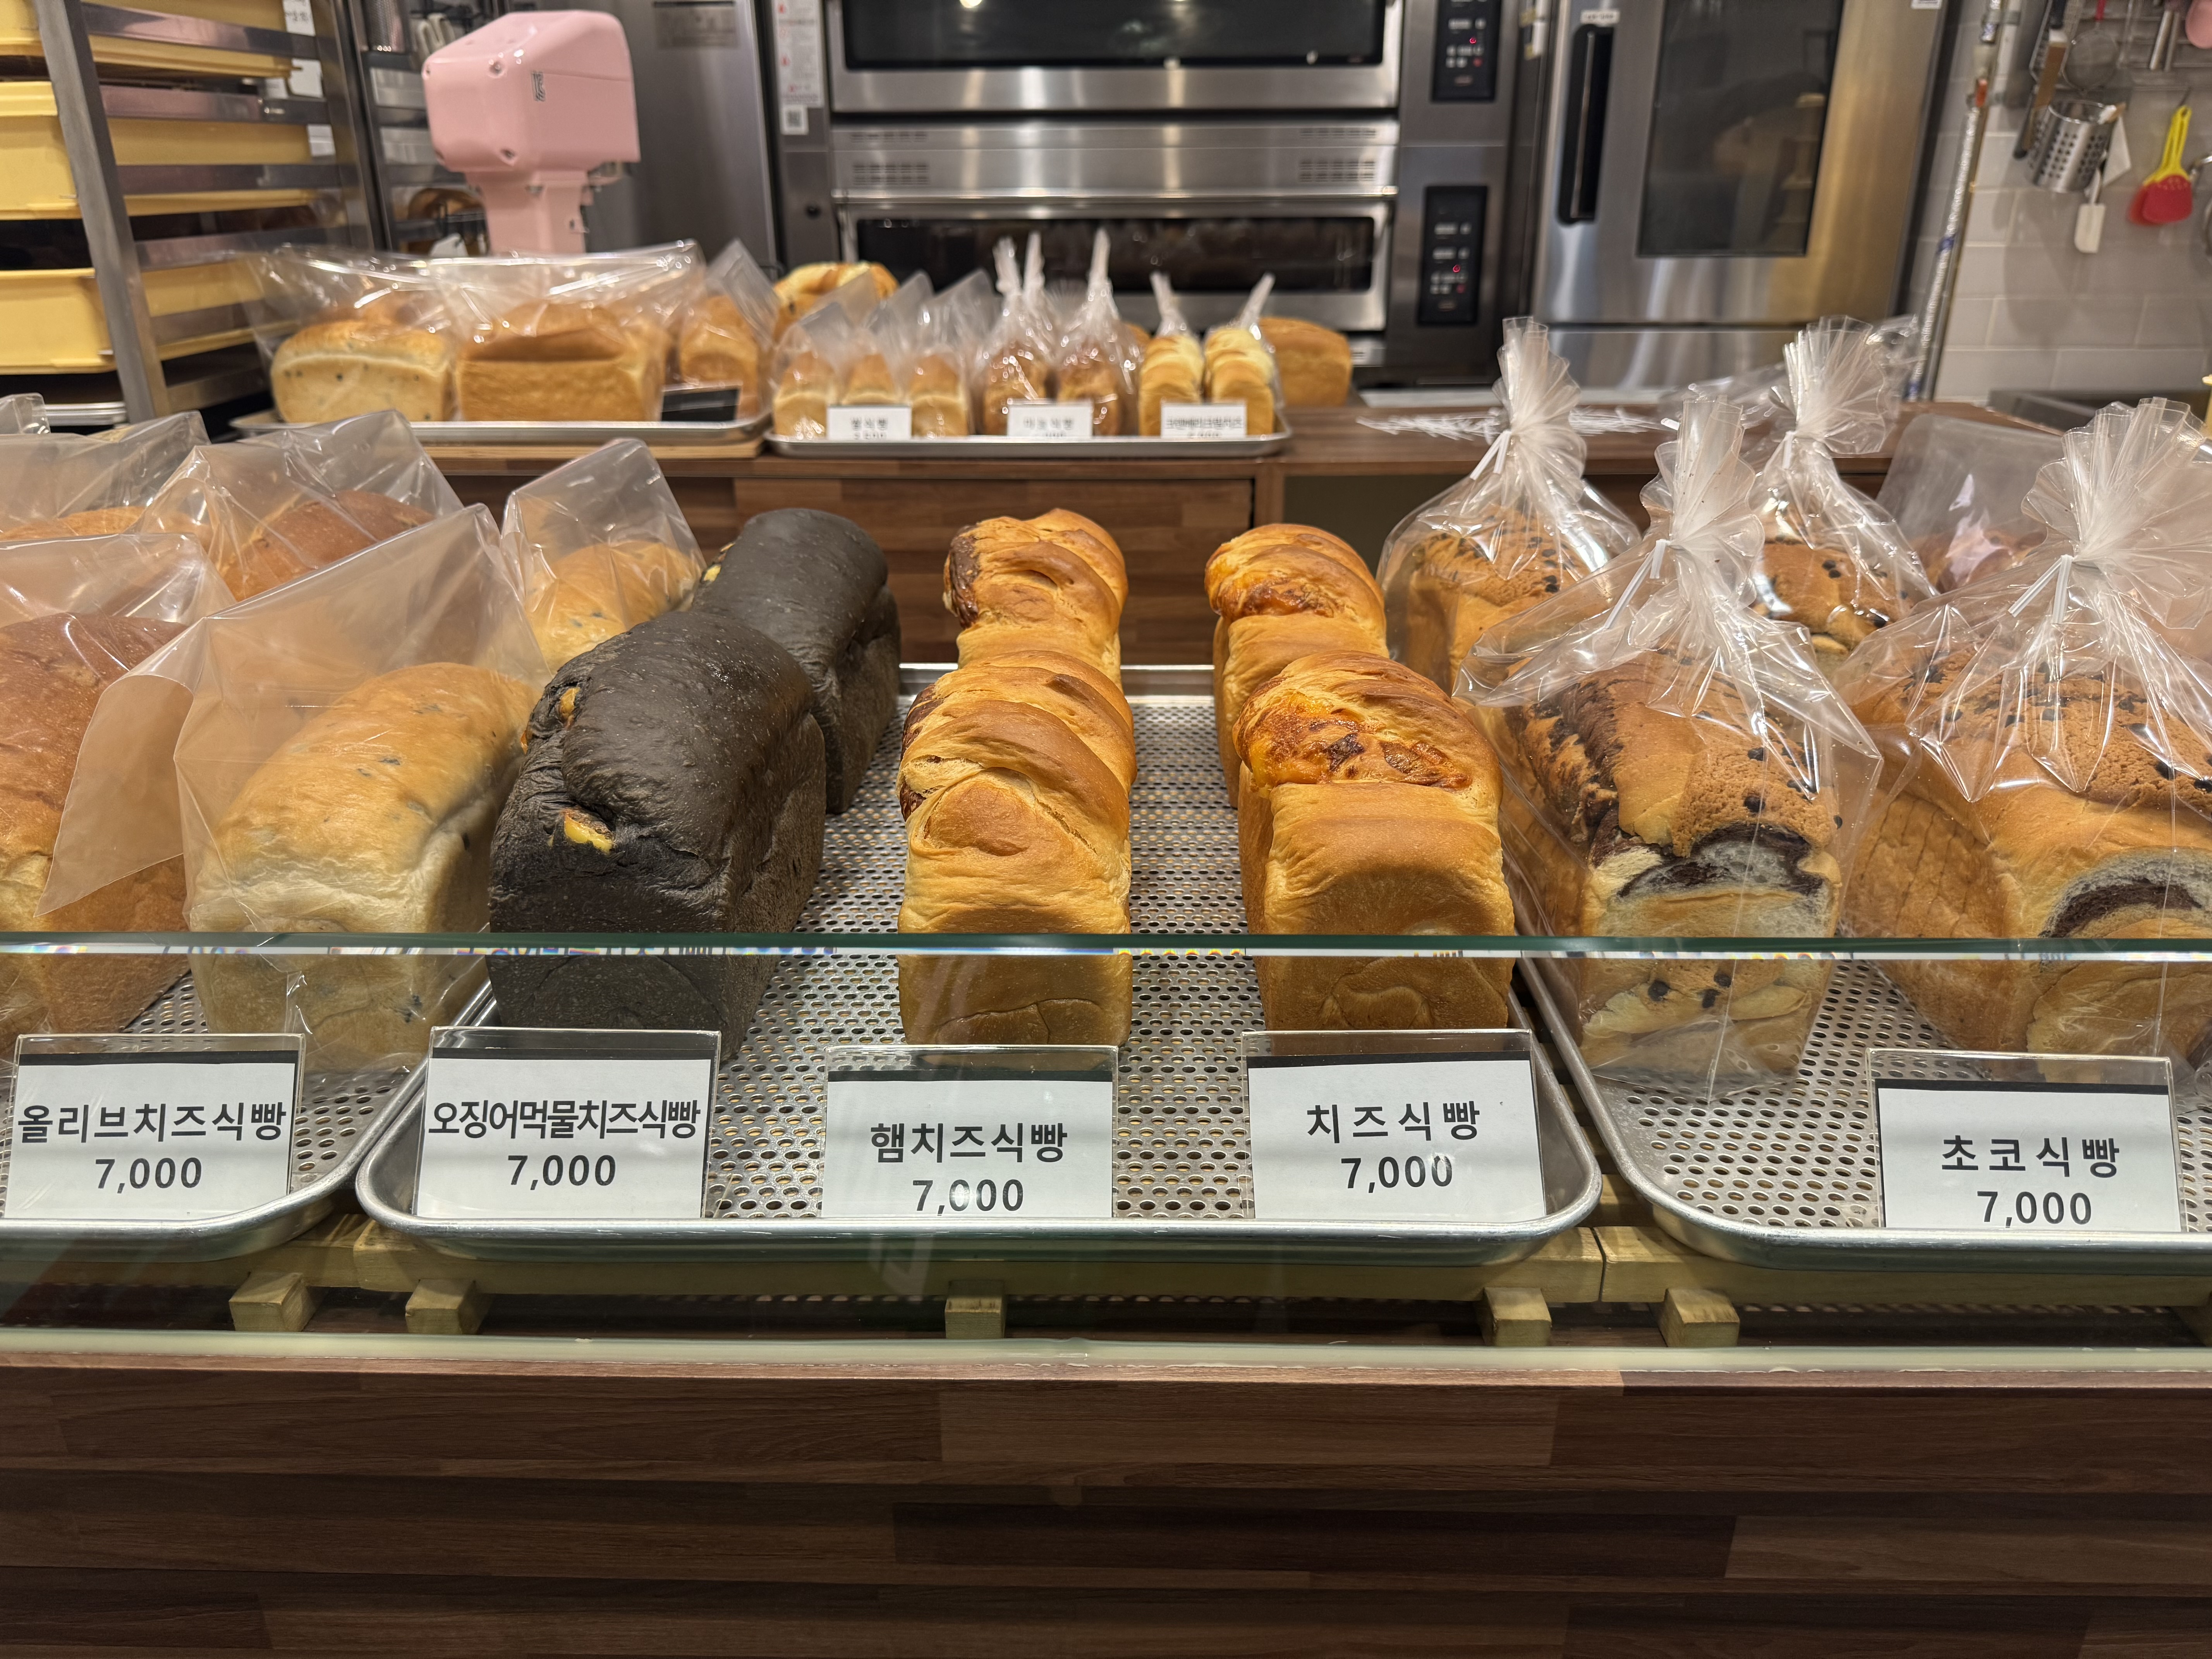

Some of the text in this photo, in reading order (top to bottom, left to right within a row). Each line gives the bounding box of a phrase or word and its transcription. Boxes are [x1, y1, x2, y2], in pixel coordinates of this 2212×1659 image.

[18, 1102, 287, 1143] 올리브치즈식빵
[428, 1100, 701, 1139] 오징어먹물치즈식빵
[1307, 1101, 1480, 1144] 치즈식빵
[871, 1123, 1068, 1163] 햄치즈식빵
[1942, 1135, 2119, 1178] 초코식빵
[96, 1157, 202, 1194] 7,000
[508, 1155, 616, 1189] 7,000
[1341, 1156, 1453, 1193] 7,000
[913, 1179, 1023, 1216] 7,000
[1977, 1191, 2091, 1228] 7,000
